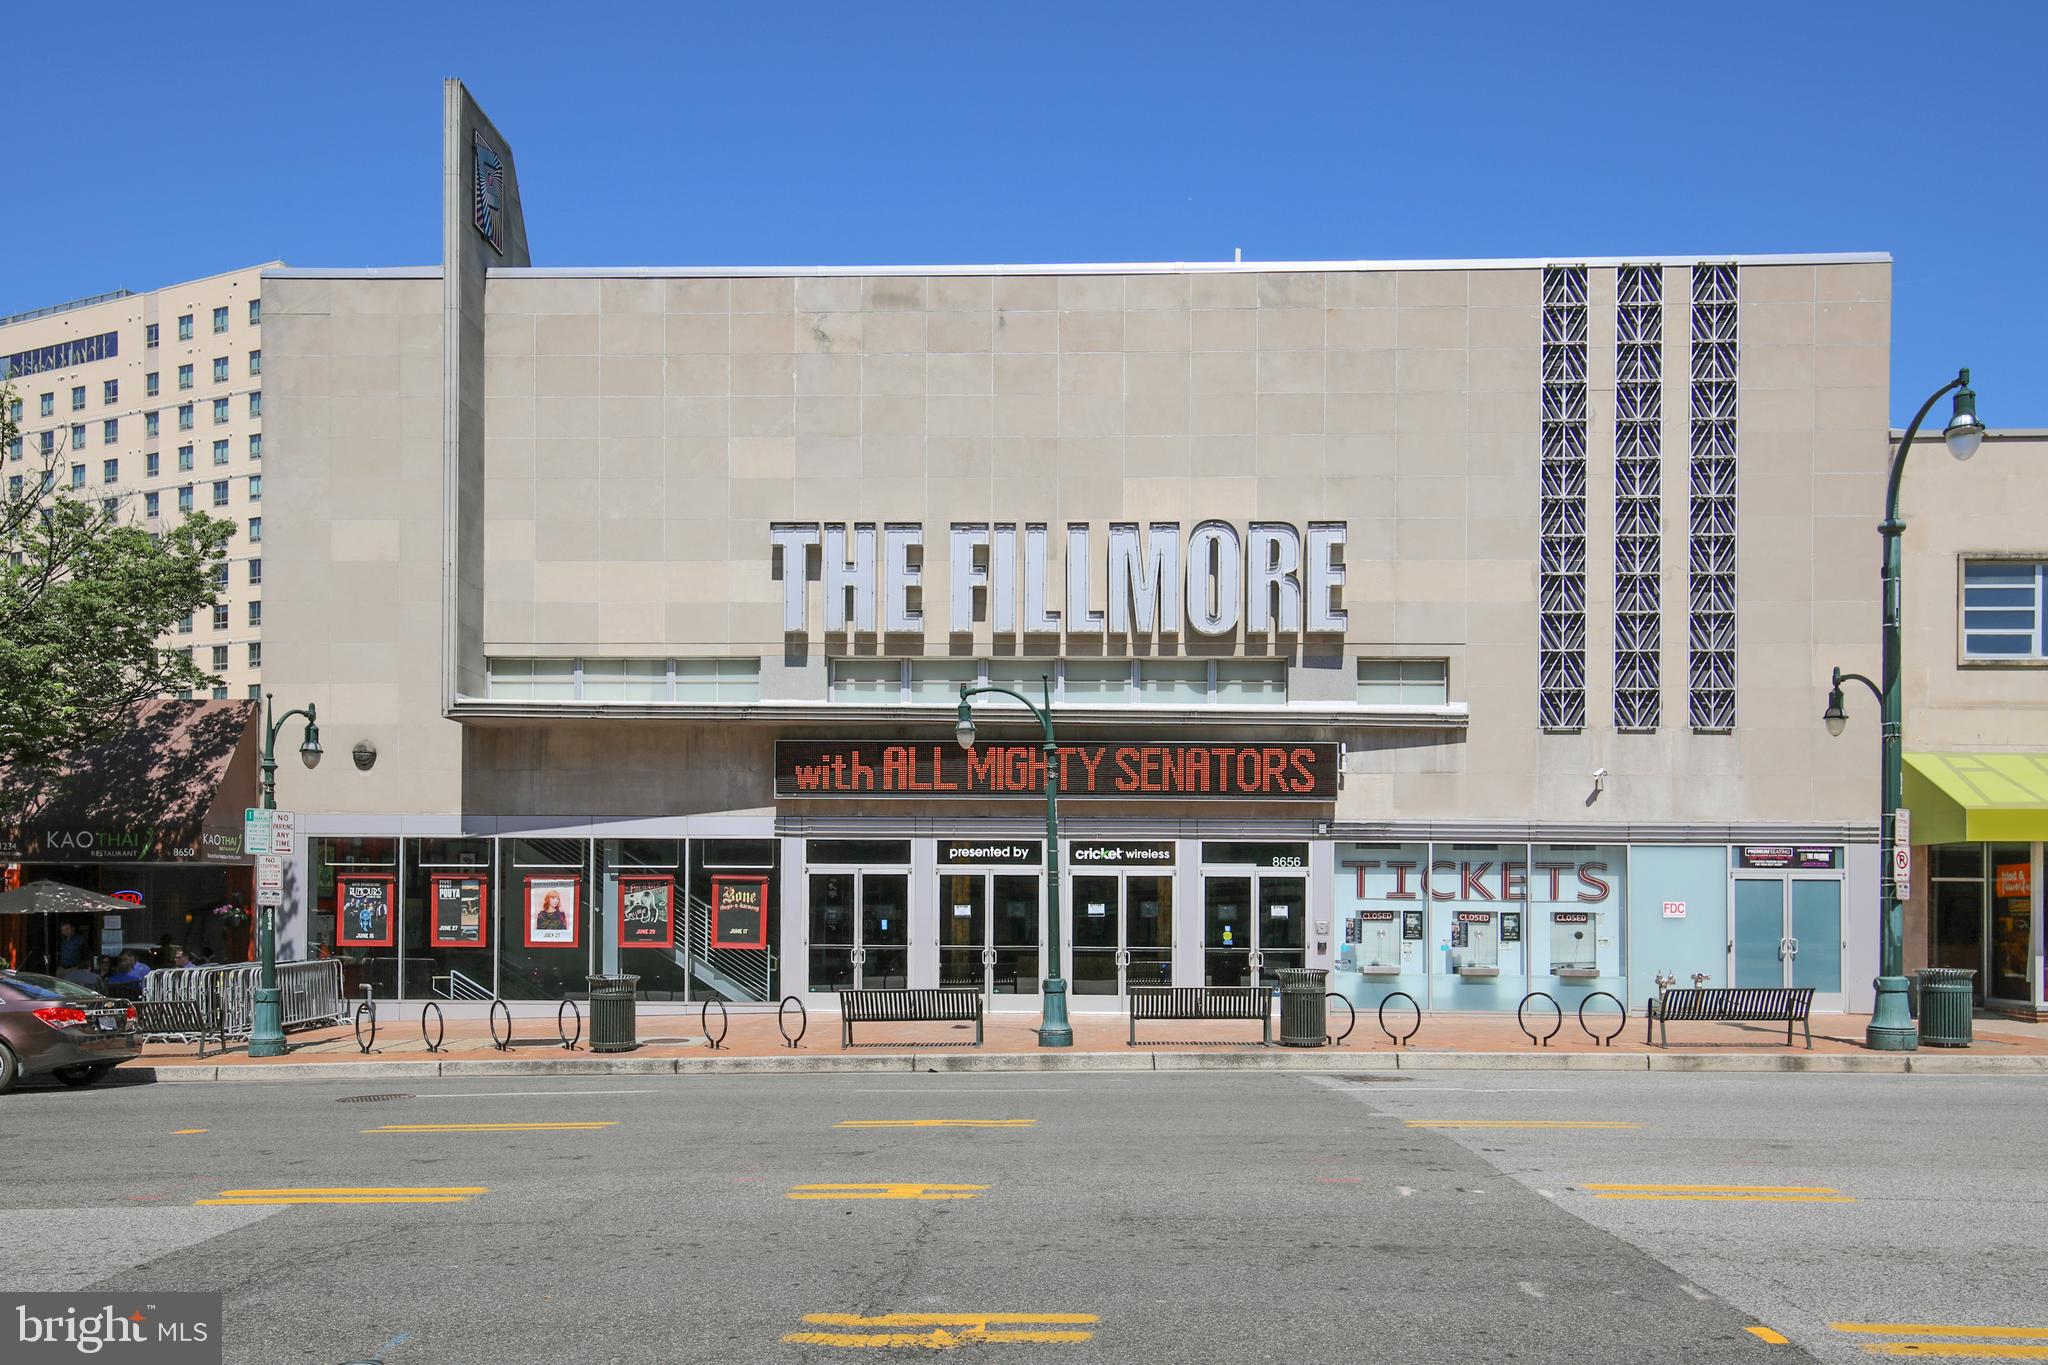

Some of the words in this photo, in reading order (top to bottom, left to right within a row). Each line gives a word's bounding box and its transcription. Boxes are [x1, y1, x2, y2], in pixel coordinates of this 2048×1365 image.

[770, 521, 923, 633] THE
[950, 519, 1347, 637] FILLMORE
[795, 751, 874, 790] with
[883, 746, 958, 790] ALL
[967, 747, 1106, 791] MIGHTY
[1115, 747, 1316, 792] SENATORS
[46, 831, 94, 848] KAO
[96, 832, 138, 847] THAI
[202, 833, 221, 846] KAO
[221, 836, 237, 846] THAI
[173, 847, 195, 857] 8650
[949, 846, 1010, 859] presented
[1013, 846, 1030, 860] by
[1075, 847, 1122, 860] cricket
[1125, 848, 1170, 859] wireless
[1272, 856, 1301, 867] 8656
[1342, 860, 1610, 901] TICKETS
[349, 887, 382, 898] RUMOURS
[439, 889, 460, 898] POUYA
[722, 886, 757, 904] Bone
[1663, 903, 1685, 913] FDC
[1362, 912, 1393, 920] CLOSED
[1459, 913, 1489, 922] CLOSED
[1556, 914, 1587, 922] CLOSED
